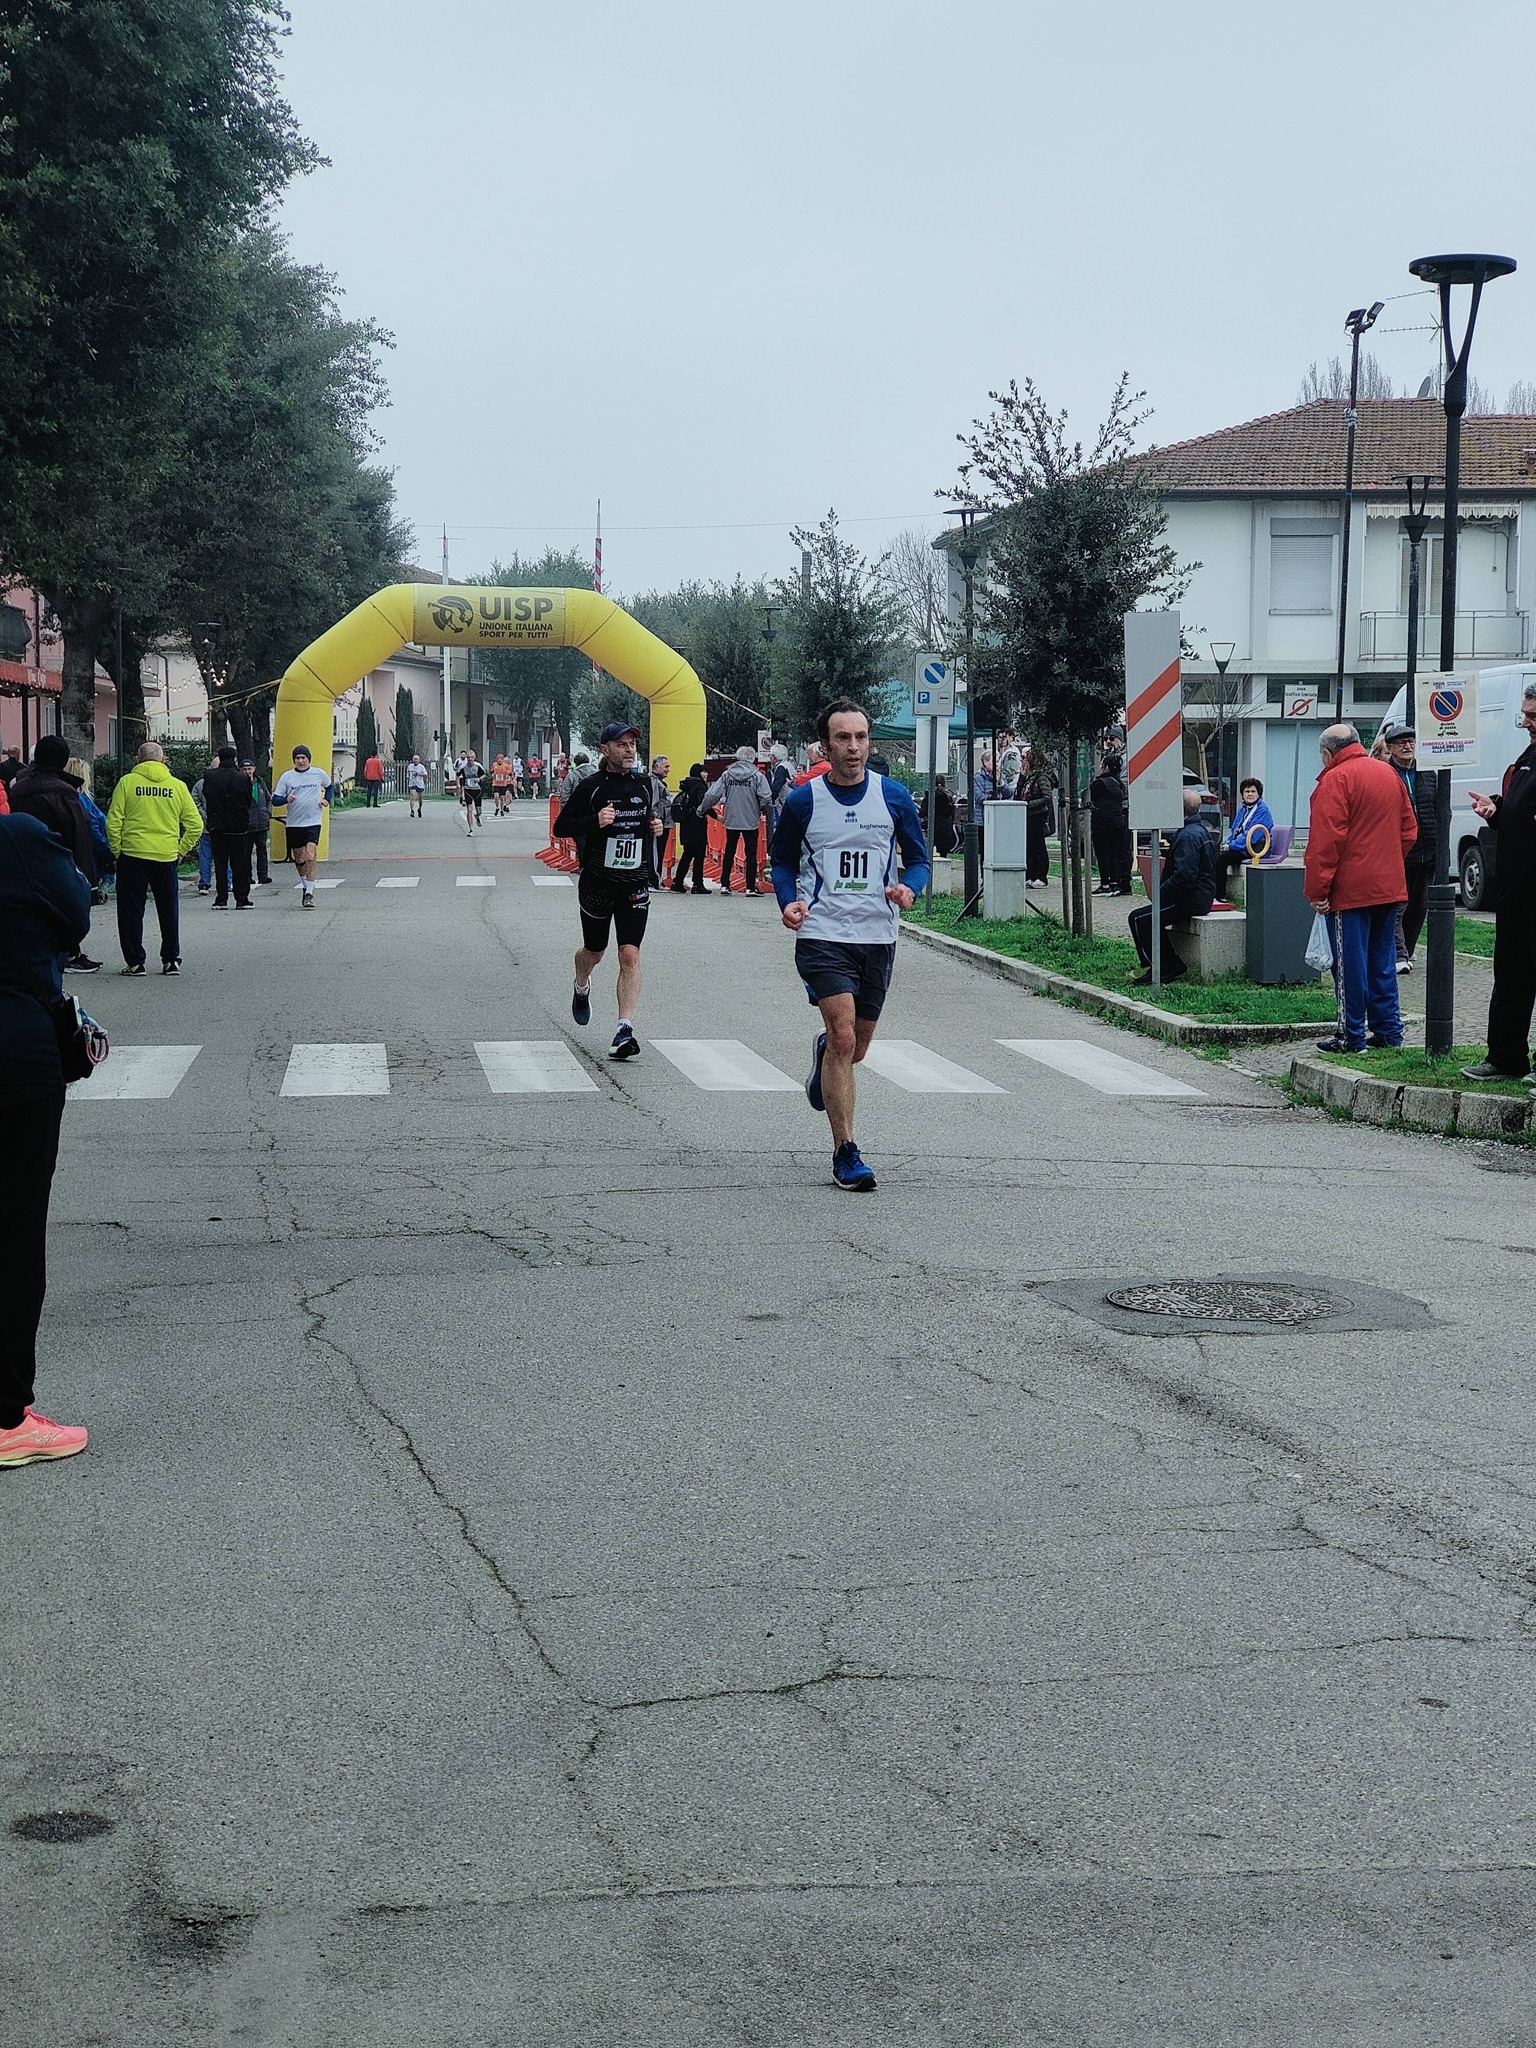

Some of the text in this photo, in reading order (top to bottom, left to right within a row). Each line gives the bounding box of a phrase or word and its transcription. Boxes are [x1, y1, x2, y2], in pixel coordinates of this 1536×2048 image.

[479, 596, 553, 621] UISP
[479, 621, 553, 631] UNIONE ITALIANA
[479, 630, 505, 638] SPORT
[526, 631, 549, 639] TUTTI
[135, 786, 173, 799] GIUDICE
[615, 840, 637, 859] 501
[840, 851, 868, 879] 611
